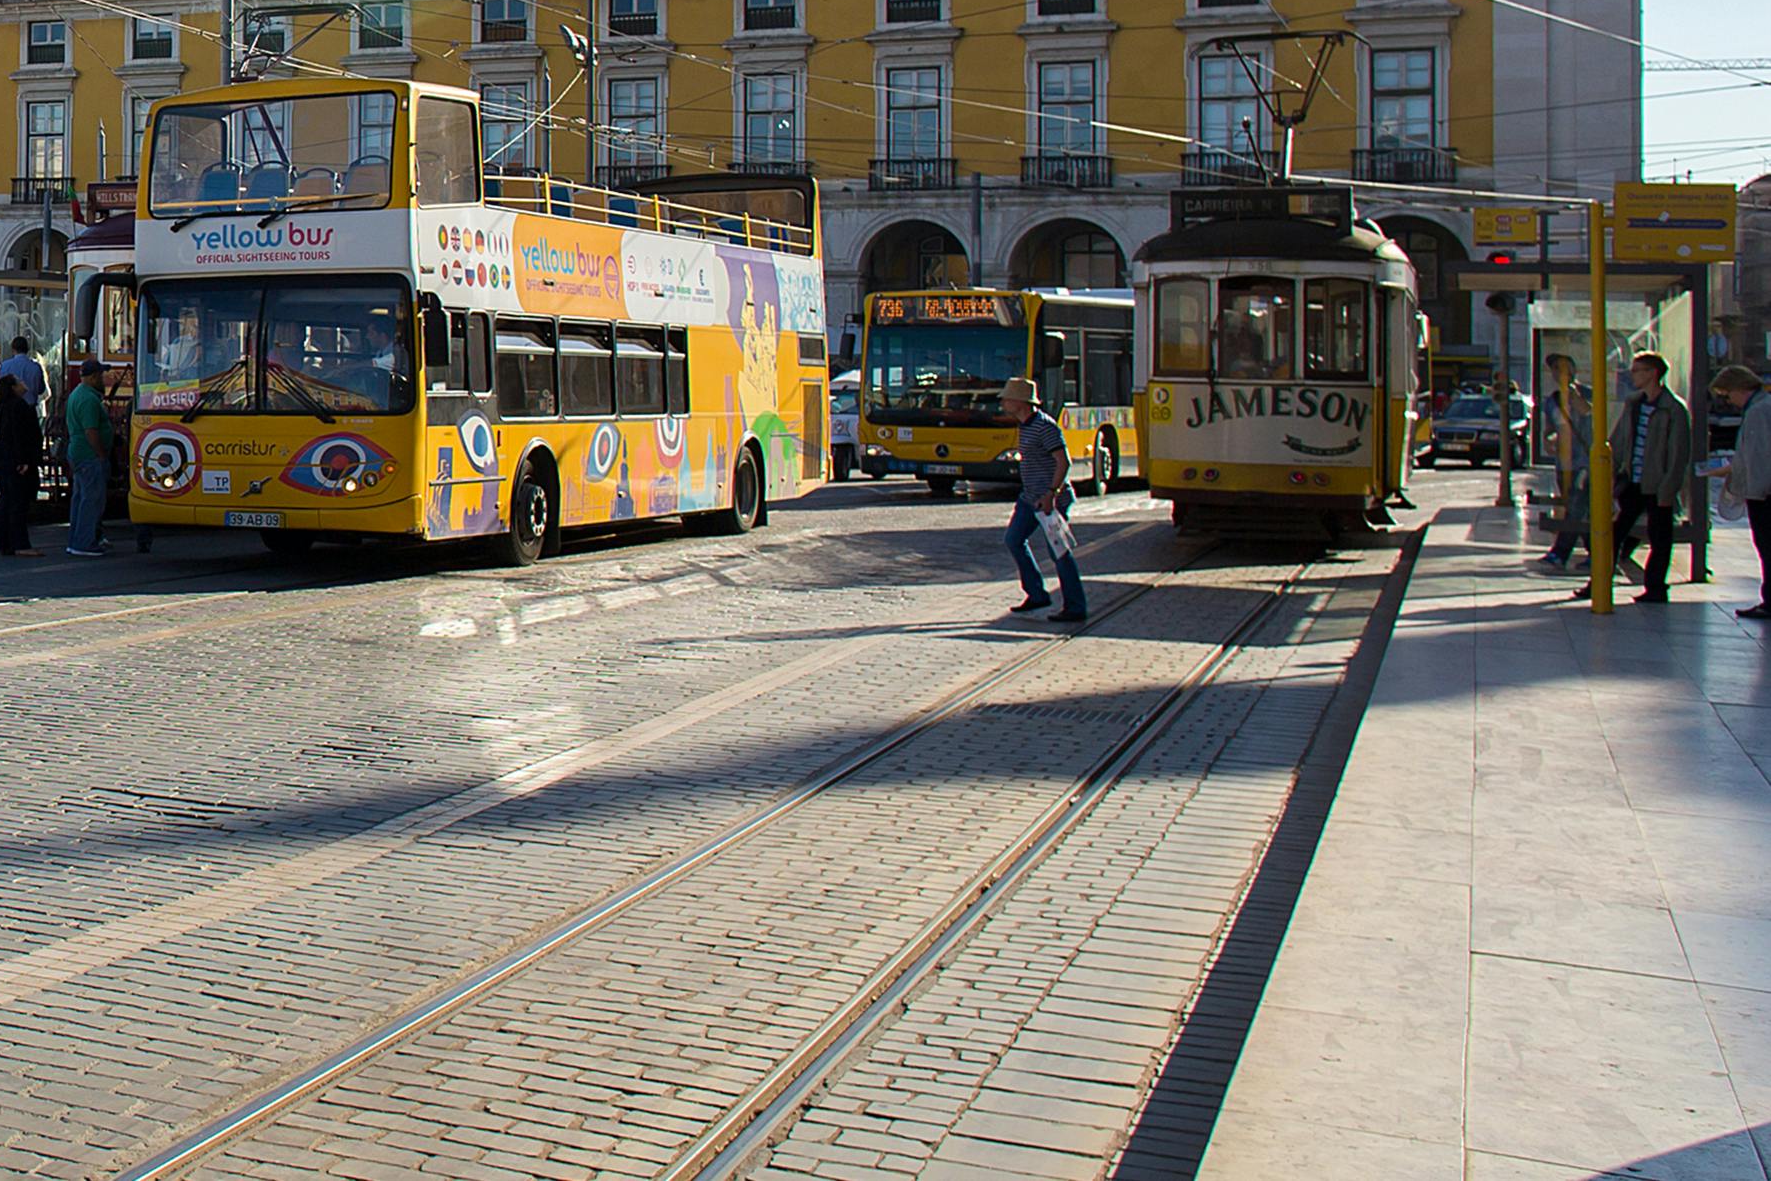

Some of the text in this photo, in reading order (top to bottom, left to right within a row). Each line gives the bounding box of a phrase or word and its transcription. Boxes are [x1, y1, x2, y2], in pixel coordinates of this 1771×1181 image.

[1184, 198, 1253, 213] CARREIRA
[191, 221, 333, 250] yellow bus
[195, 251, 330, 264] OFFICIAL SIGHTSEEING TOURS
[520, 236, 601, 278] yellow bus
[879, 299, 904, 318] 736
[1186, 386, 1369, 432] JAMESON
[204, 439, 276, 456] carristur
[214, 477, 229, 487] TP
